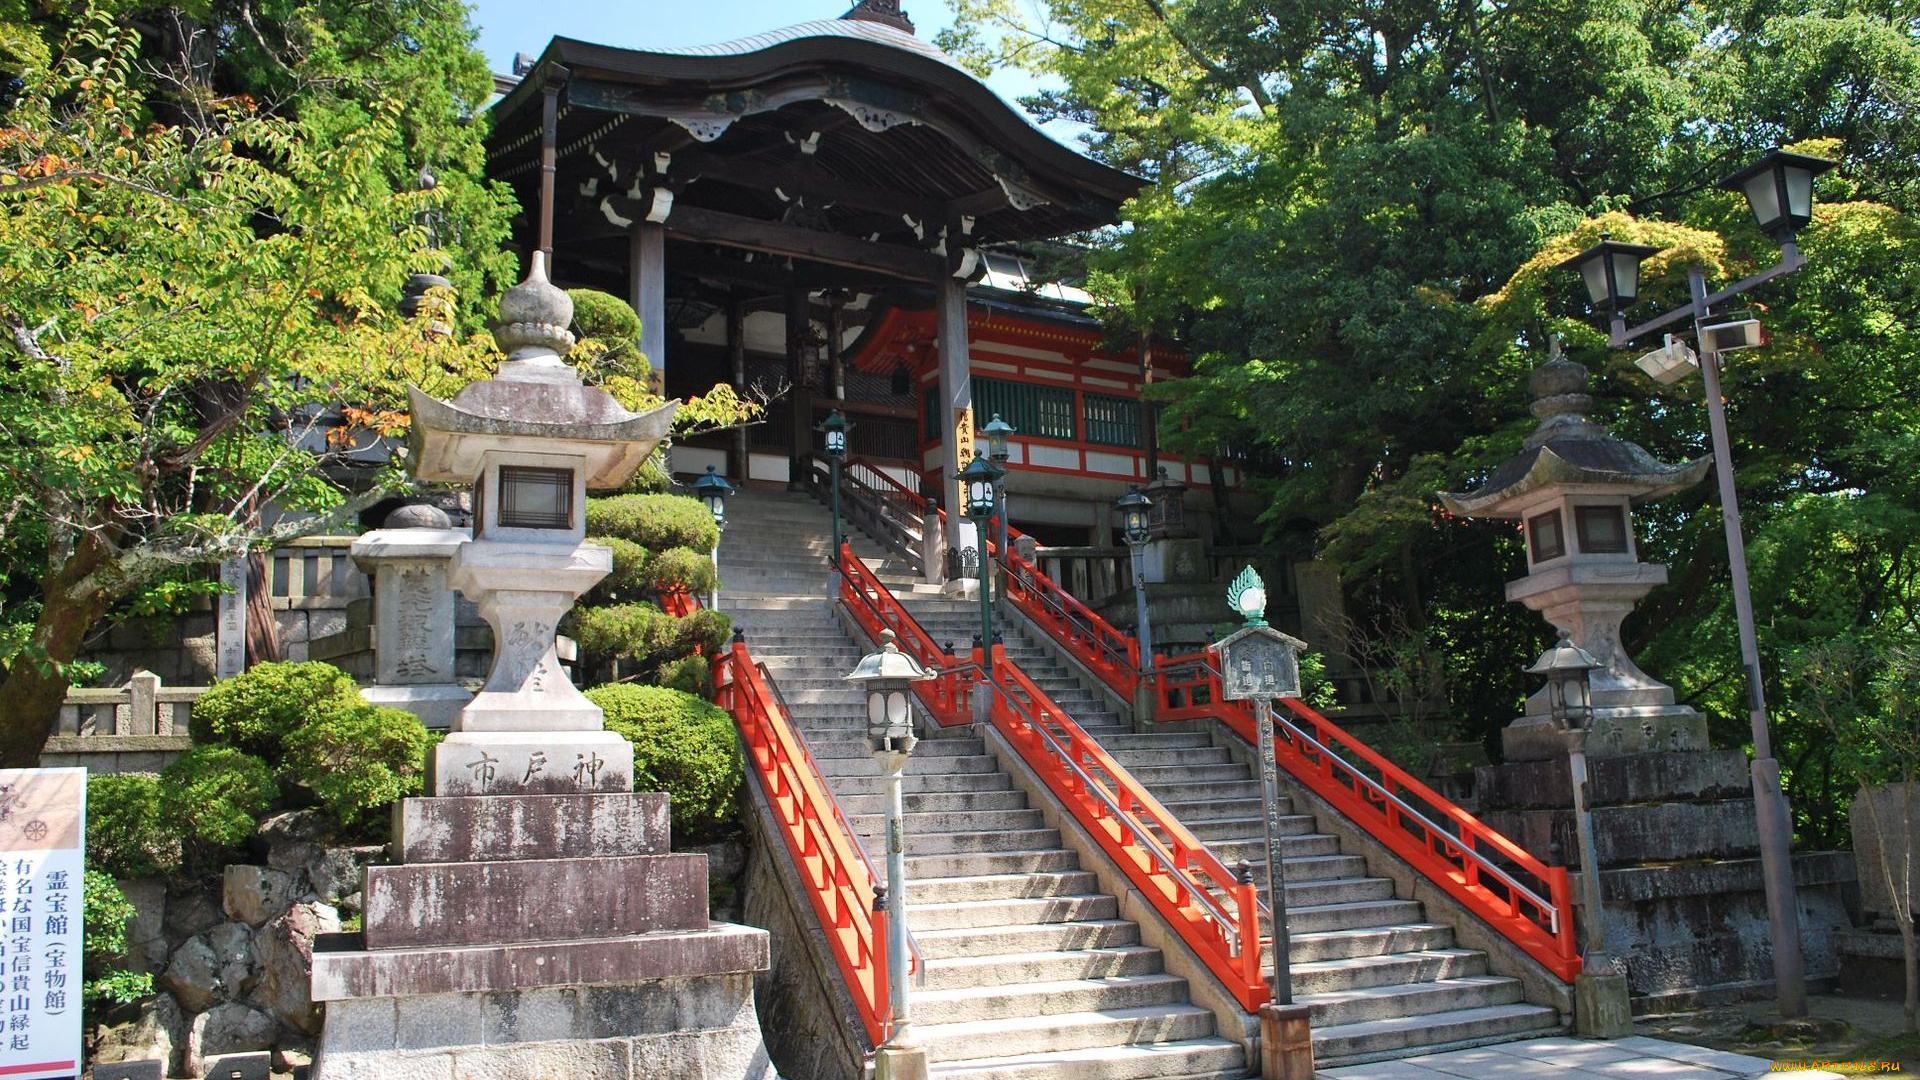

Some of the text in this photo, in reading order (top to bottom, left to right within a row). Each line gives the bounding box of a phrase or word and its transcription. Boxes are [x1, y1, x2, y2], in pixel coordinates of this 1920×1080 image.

[9, 858, 34, 1051] 有名な国宝信貴山縁起
